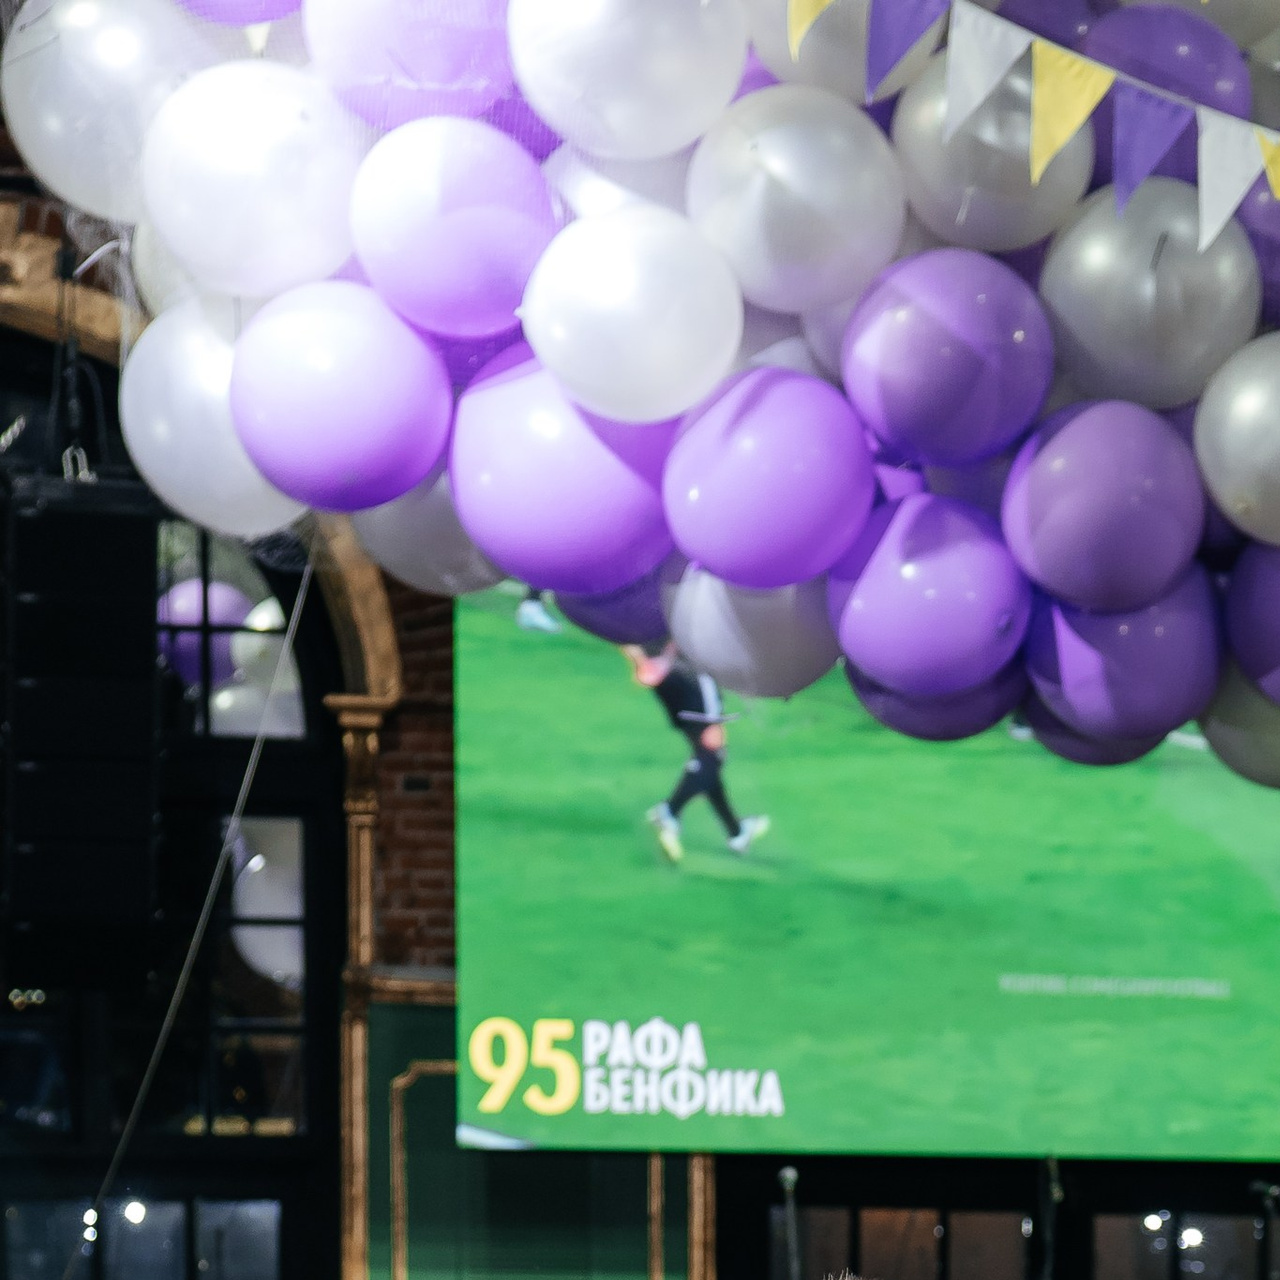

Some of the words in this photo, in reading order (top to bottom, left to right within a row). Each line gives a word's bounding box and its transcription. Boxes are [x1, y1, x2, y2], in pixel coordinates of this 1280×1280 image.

[468, 1016, 581, 1116] 95
[582, 1016, 707, 1070] РАФА
[582, 1068, 785, 1119] БЕНФИКА
